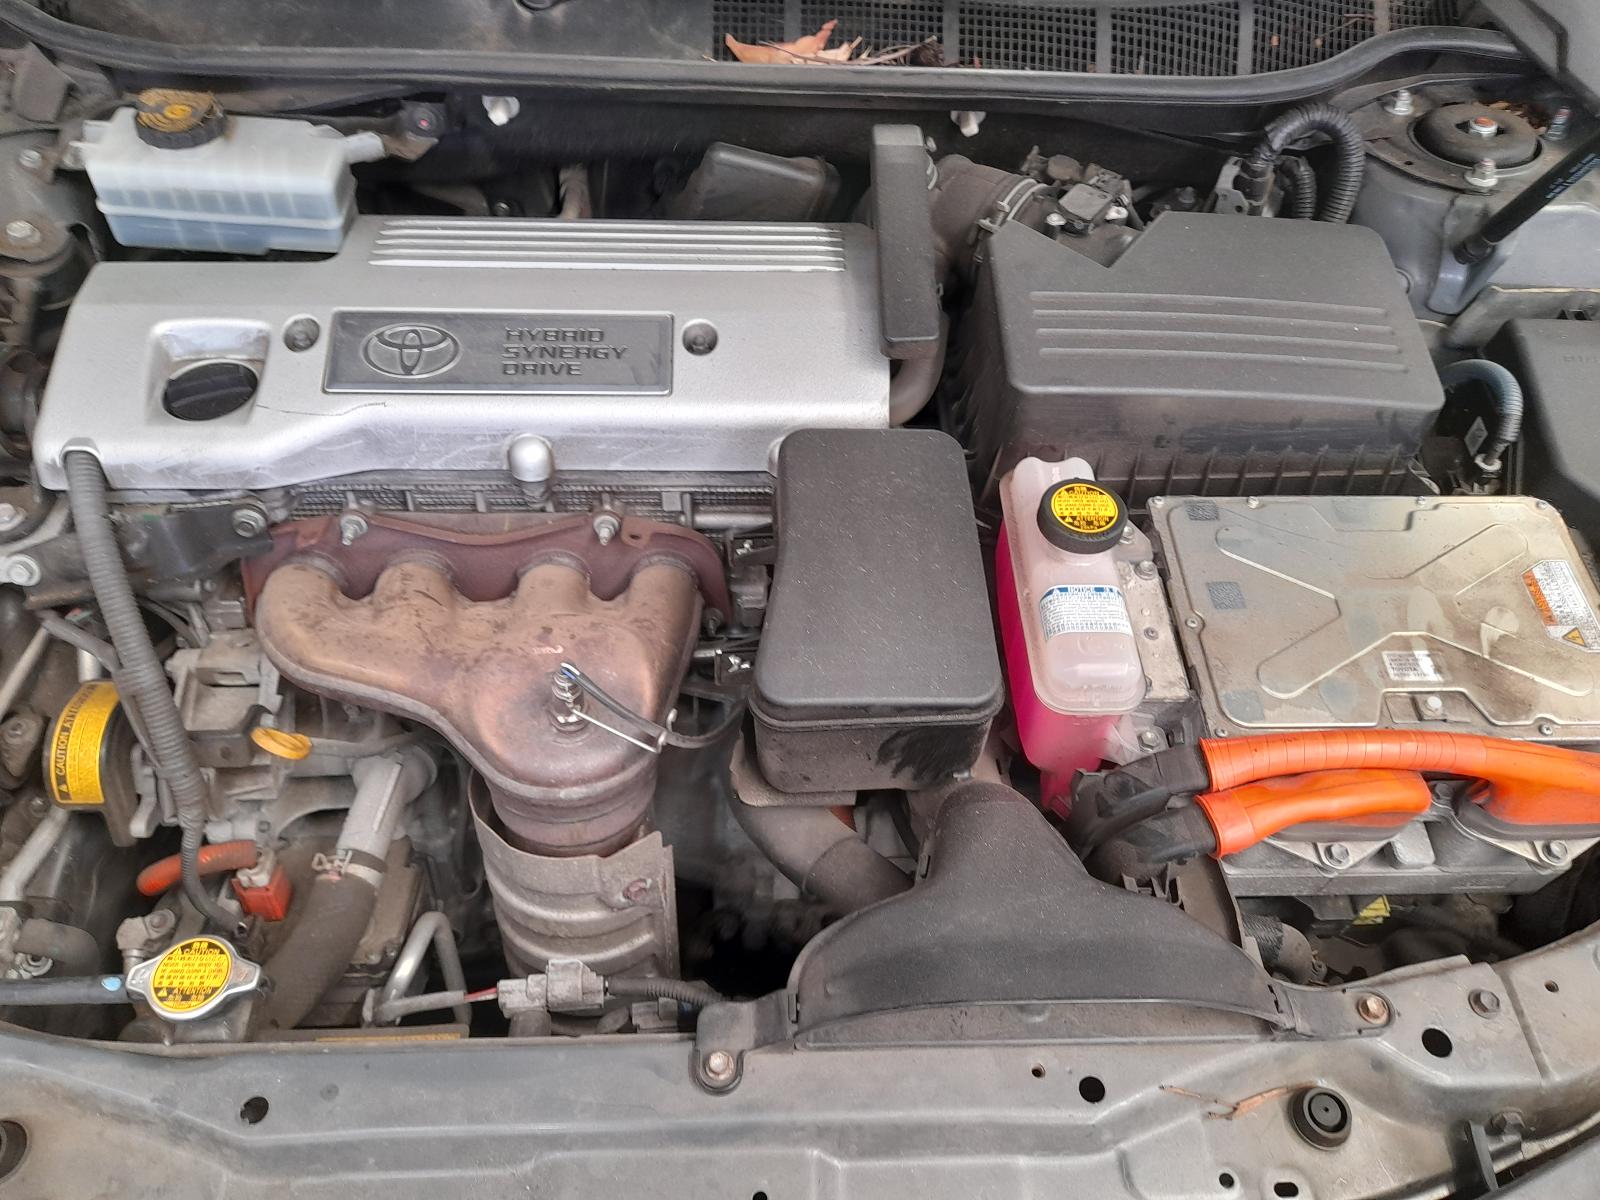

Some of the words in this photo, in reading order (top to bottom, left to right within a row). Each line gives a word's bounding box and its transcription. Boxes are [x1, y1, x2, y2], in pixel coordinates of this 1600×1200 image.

[505, 326, 605, 343] HYBRID
[502, 344, 628, 360] SYNERGY
[502, 361, 583, 376] DRIVE
[56, 732, 69, 776] CAUTION
